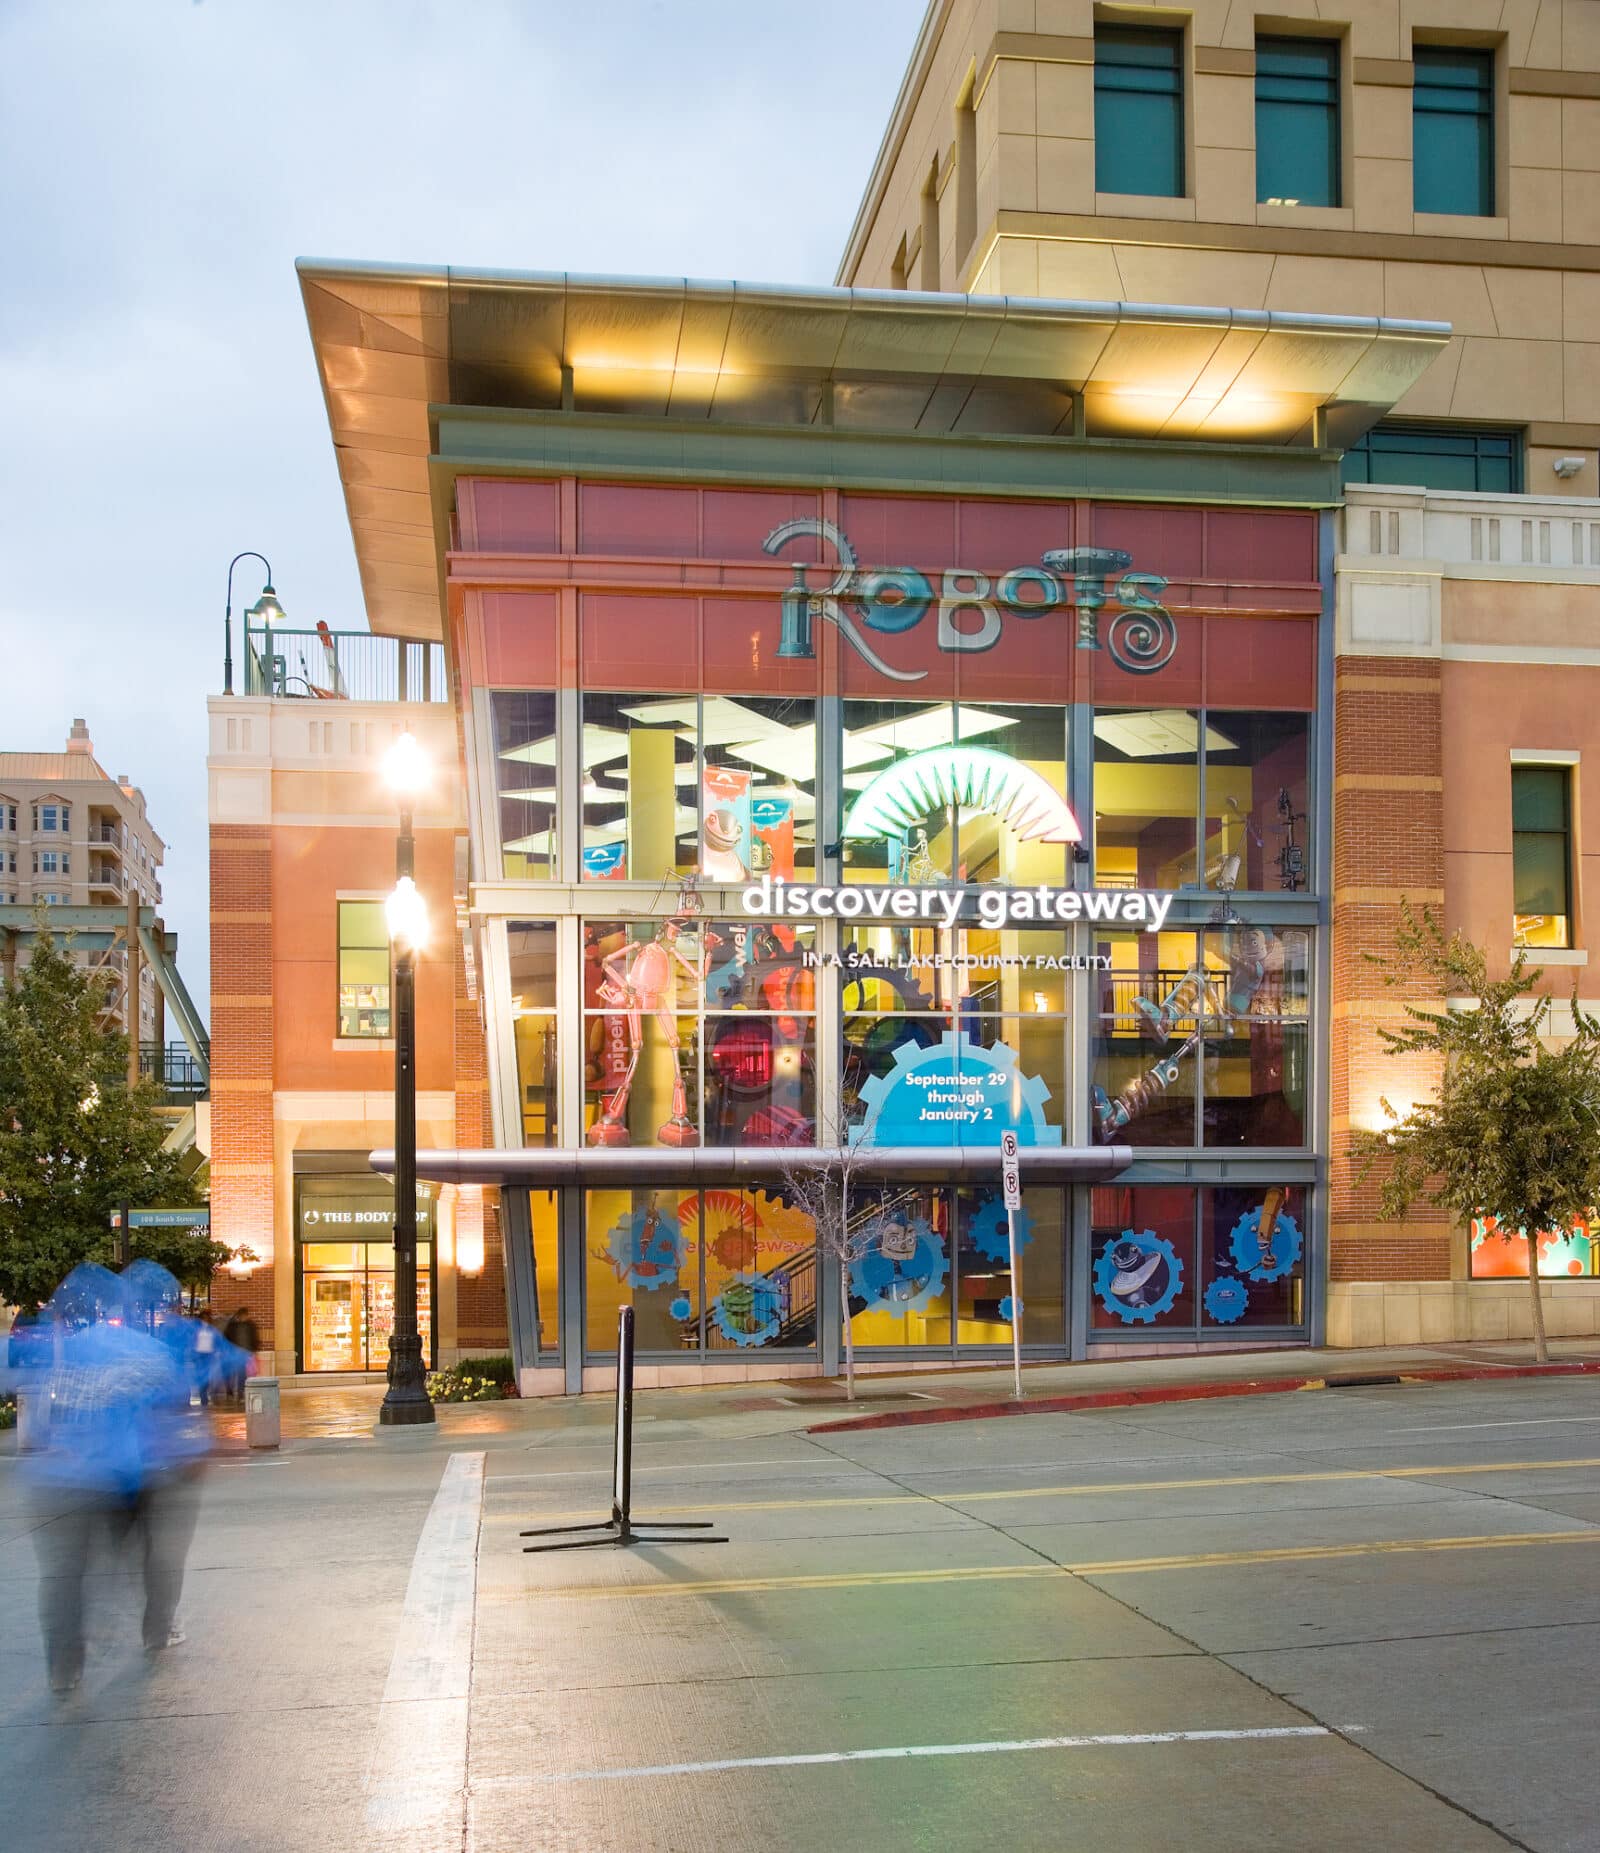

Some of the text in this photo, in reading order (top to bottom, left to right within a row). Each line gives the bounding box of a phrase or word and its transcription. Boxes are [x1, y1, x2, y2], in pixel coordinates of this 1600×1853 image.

[742, 877, 1173, 932] discovery gateway
[802, 951, 1113, 970] IN A SALT LAKE COUNTY FACILITY
[607, 1015, 628, 1073] piper
[905, 1072, 1007, 1088] September 29
[927, 1090, 985, 1106] through
[918, 1108, 993, 1124] January 2
[322, 1212, 352, 1223] THE
[355, 1211, 391, 1223] BODY
